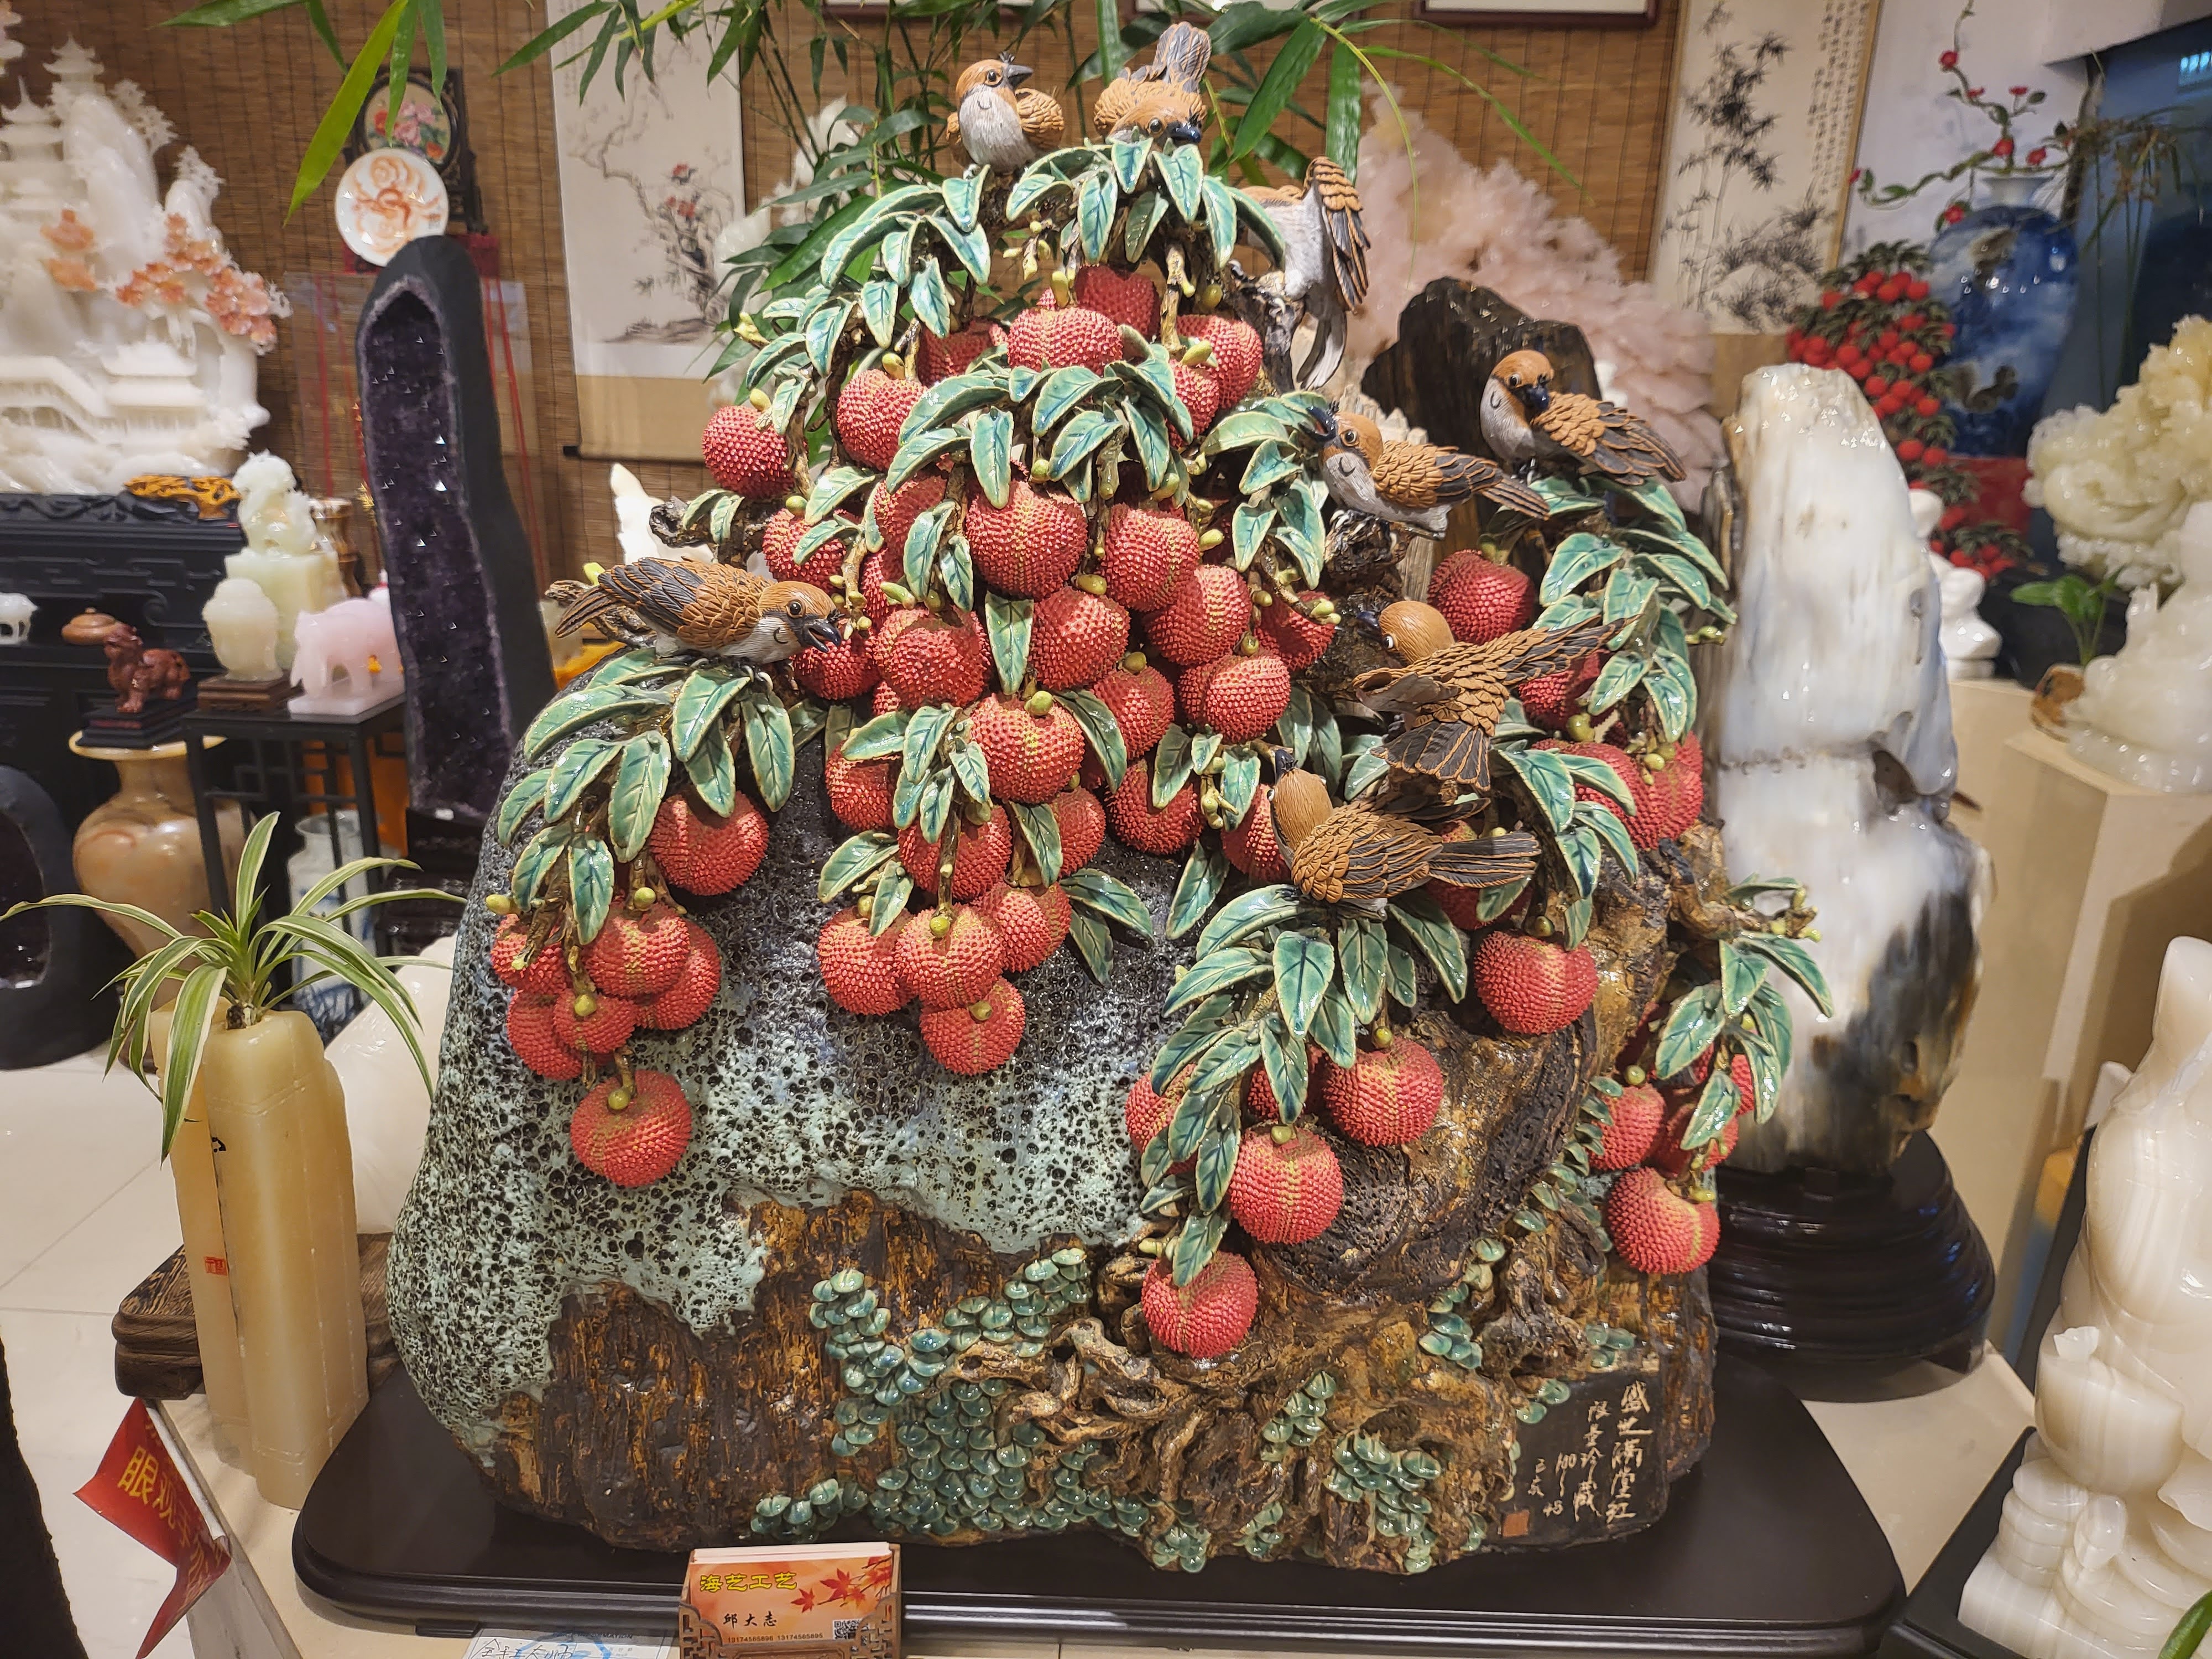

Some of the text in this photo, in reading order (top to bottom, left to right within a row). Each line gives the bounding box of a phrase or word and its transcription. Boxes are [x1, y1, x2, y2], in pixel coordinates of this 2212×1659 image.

[700, 1571, 797, 1593] 海艺工艺
[723, 1610, 777, 1629] 邱大志
